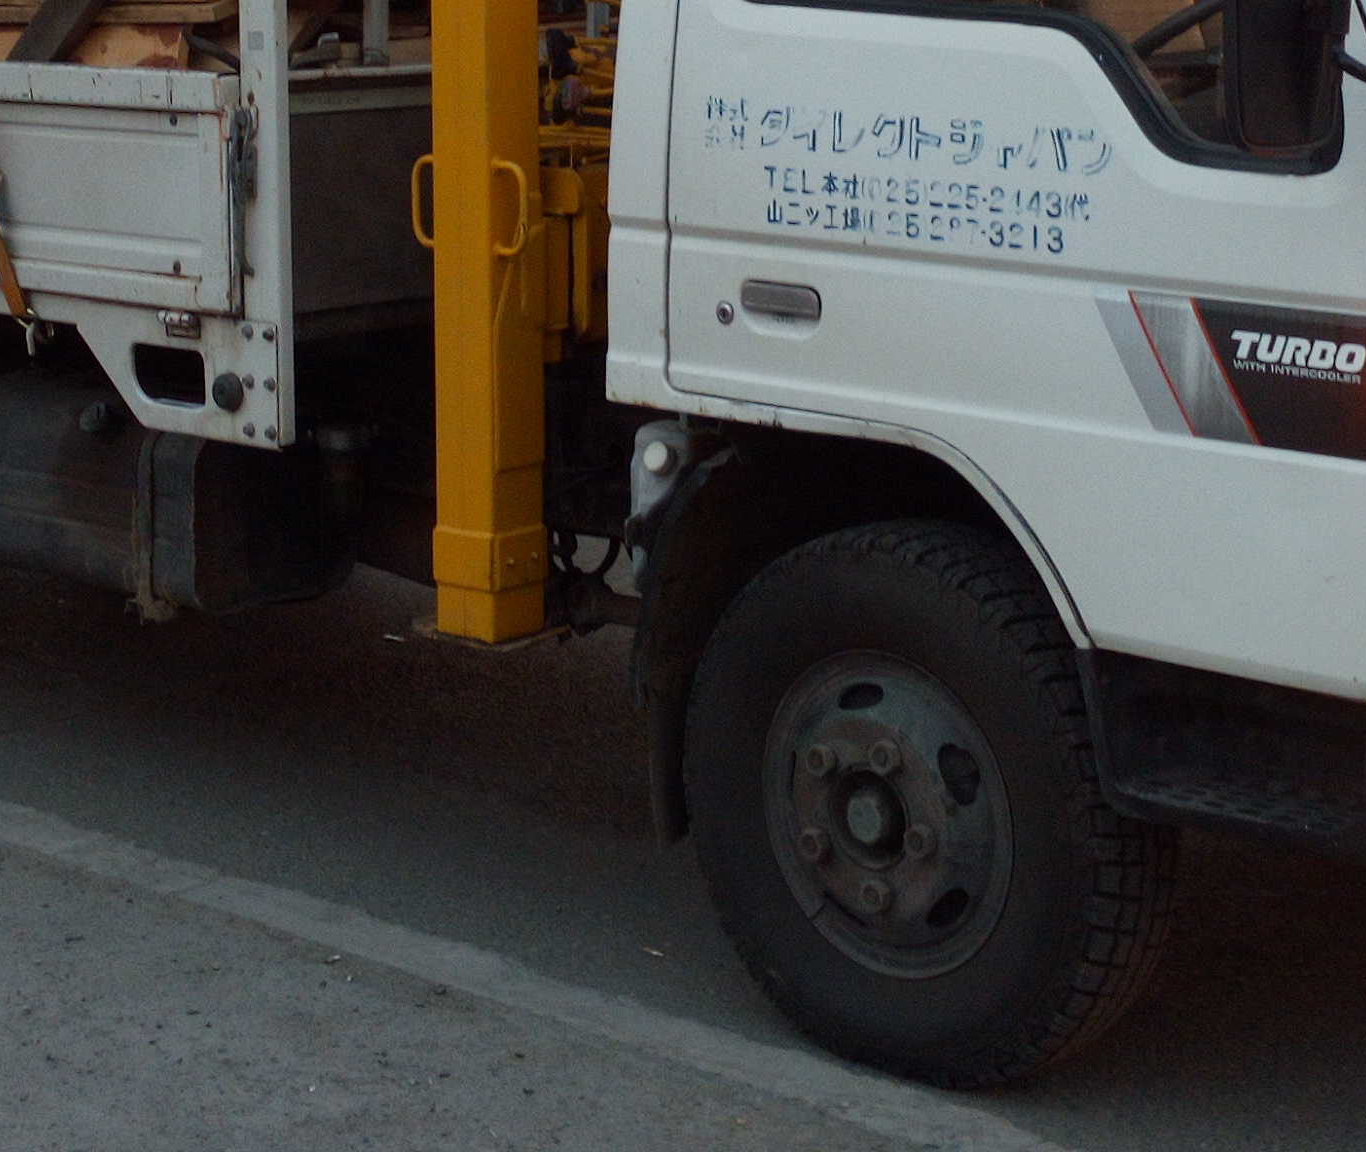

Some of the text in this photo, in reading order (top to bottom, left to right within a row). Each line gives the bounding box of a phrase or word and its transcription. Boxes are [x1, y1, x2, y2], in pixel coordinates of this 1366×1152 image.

[764, 165, 815, 195] TEL
[1230, 329, 1366, 374] TURBO
[1232, 358, 1362, 385] WITH INTERCOOLER
